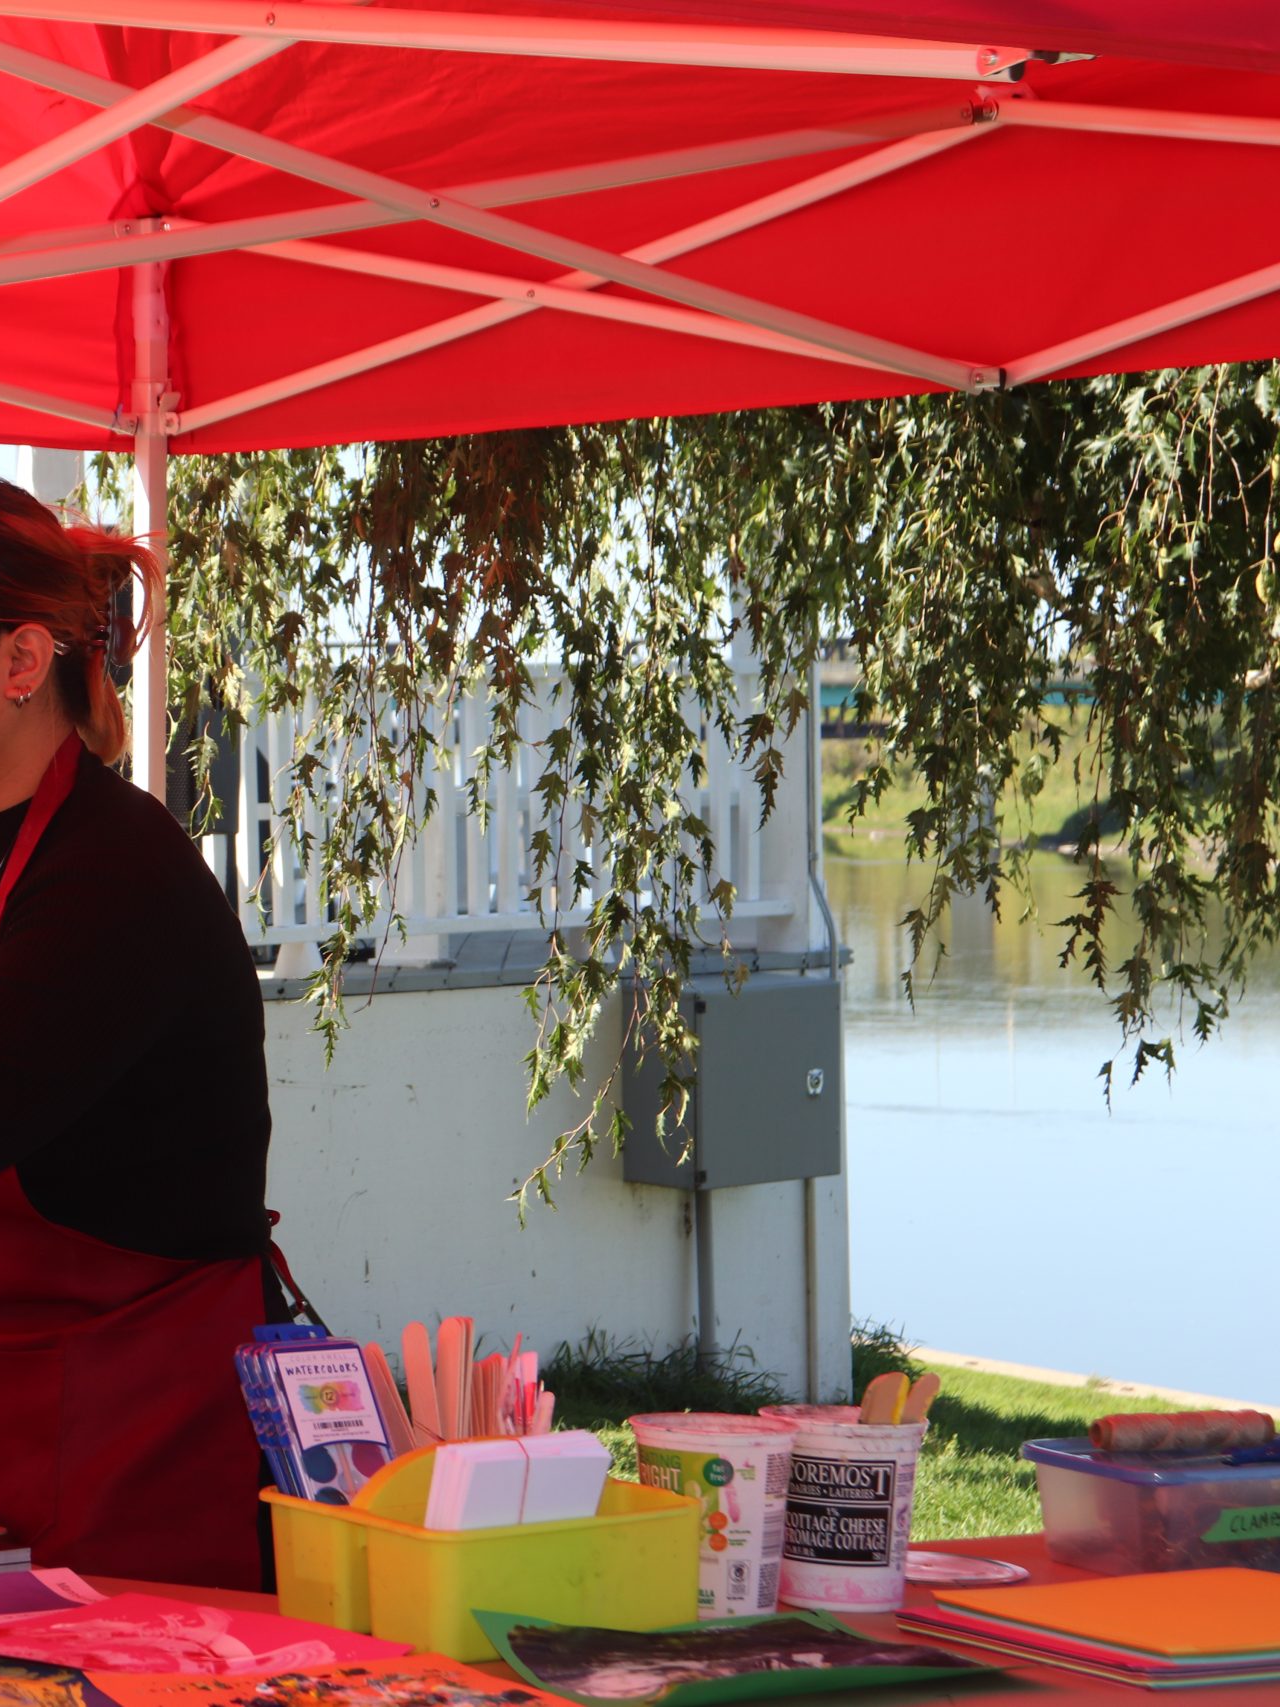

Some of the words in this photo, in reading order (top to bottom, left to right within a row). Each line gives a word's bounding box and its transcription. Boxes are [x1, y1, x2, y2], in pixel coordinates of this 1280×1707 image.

[285, 1362, 359, 1376] WATERCOLORS
[785, 1511, 837, 1533] COTTAGE
[839, 1517, 886, 1535] CHEESE
[834, 1533, 887, 1551] COTTAGE
